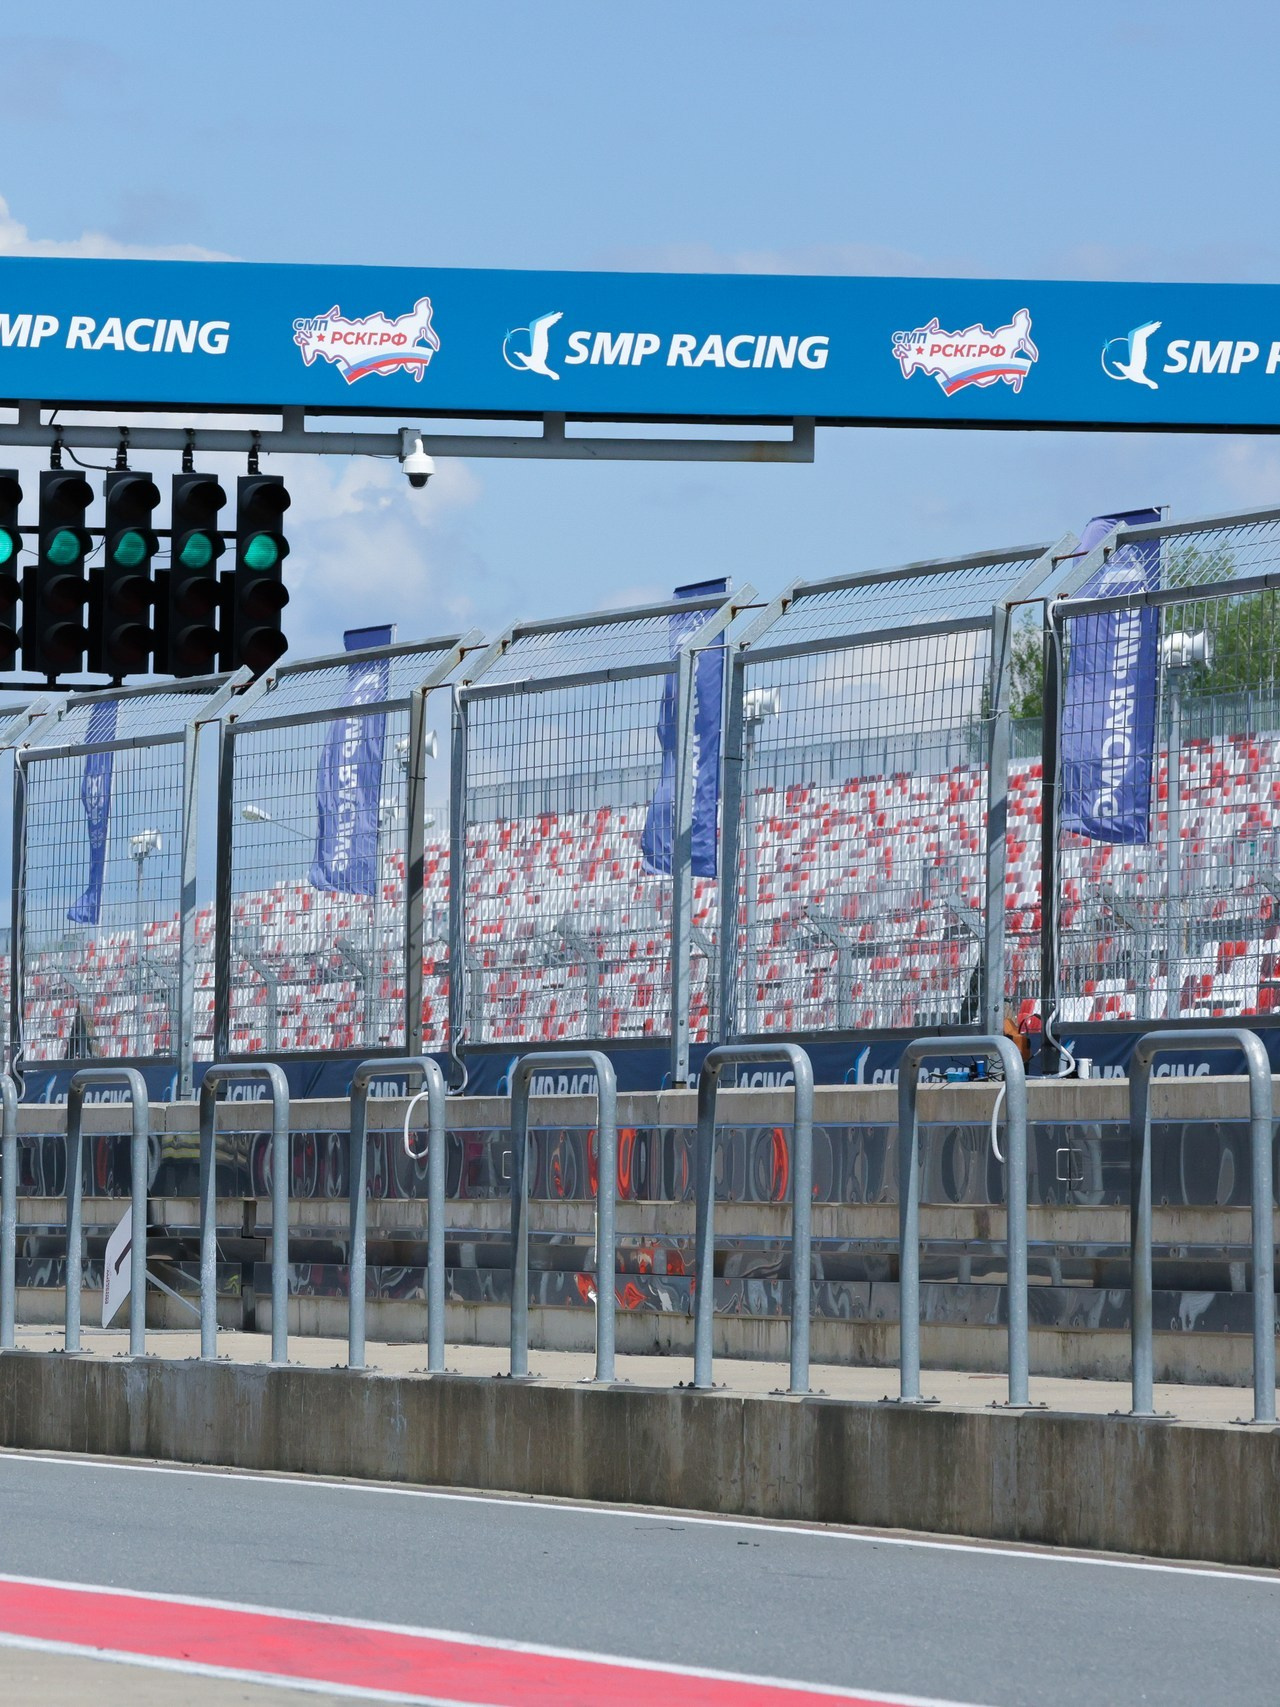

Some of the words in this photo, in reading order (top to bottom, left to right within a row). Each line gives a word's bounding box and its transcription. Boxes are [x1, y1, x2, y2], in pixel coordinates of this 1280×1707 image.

[293, 319, 329, 331] СМП
[65, 316, 231, 354] RACING
[330, 331, 408, 346] РСКГ.РФ
[892, 332, 927, 344] СМП
[564, 331, 661, 365] SMP
[666, 334, 830, 369] RACING
[929, 344, 1006, 357] РСКГ.РФ
[1163, 340, 1260, 374] SMP
